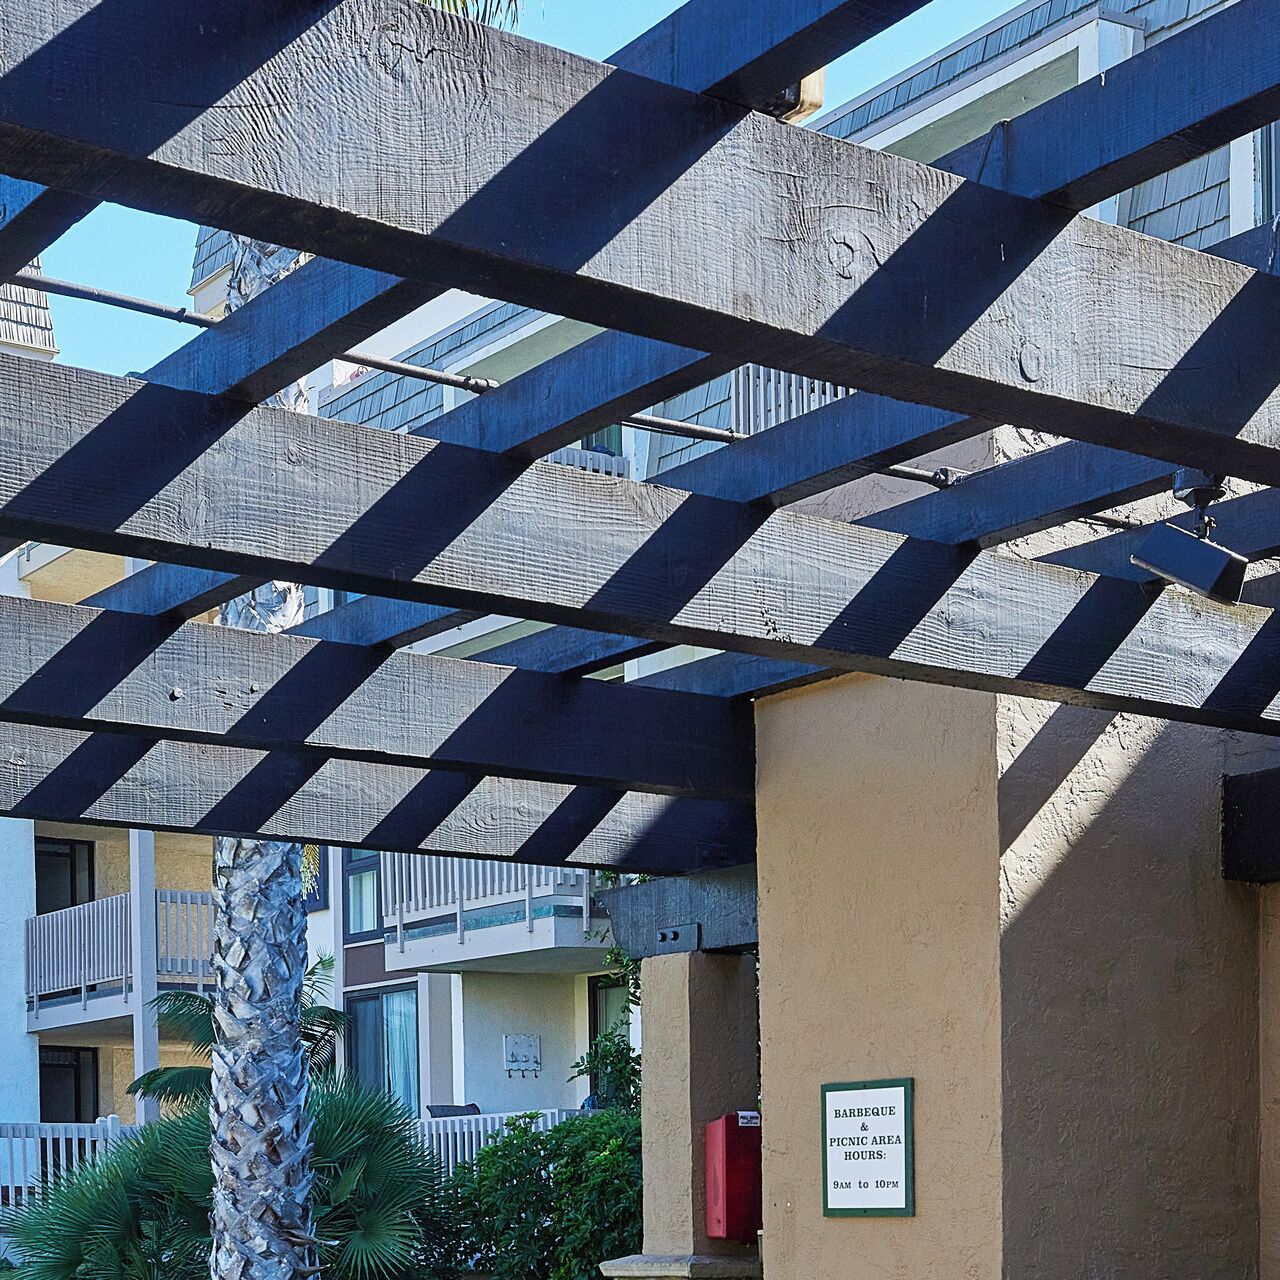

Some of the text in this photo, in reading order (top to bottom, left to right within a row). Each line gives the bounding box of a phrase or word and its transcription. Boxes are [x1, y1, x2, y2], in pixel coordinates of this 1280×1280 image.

[834, 1106, 896, 1119] BARBEQUE
[860, 1122, 869, 1132] &
[829, 1135, 902, 1147] PICNIC AREA
[844, 1150, 887, 1161] HOURS:
[833, 1179, 899, 1189] 9AM to 10PM
